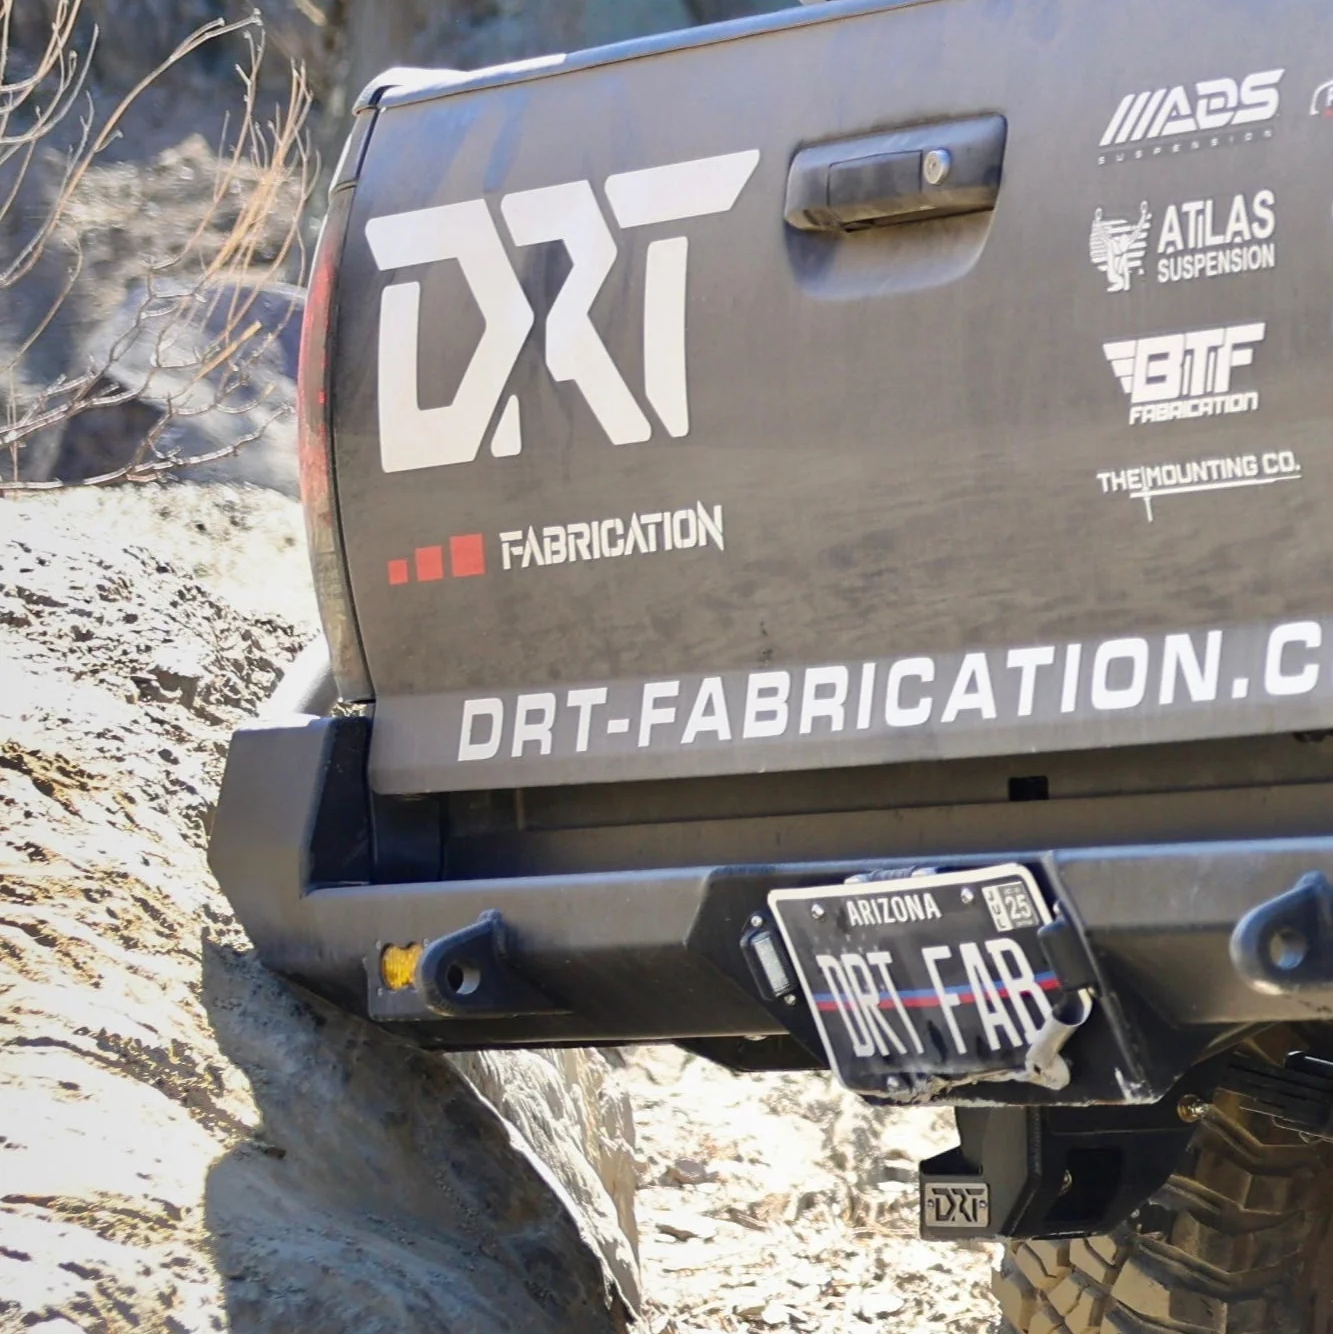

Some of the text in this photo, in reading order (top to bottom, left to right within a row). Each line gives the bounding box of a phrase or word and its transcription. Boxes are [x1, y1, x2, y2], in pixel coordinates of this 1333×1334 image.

[1098, 129, 1273, 165] SUSPENSION
[1157, 189, 1275, 253] ATLAS
[1157, 243, 1275, 283] SUSPENSION
[364, 148, 761, 473] DRT
[1122, 322, 1266, 403] BTF
[1129, 391, 1259, 425] FABRICATION
[1261, 451, 1301, 474] CO.
[499, 501, 724, 571] FABRICATION
[846, 892, 942, 928] ARIZONA
[1005, 894, 1032, 920] 25
[816, 937, 1053, 1058] DRT FAB
[927, 1187, 986, 1223] DRT
